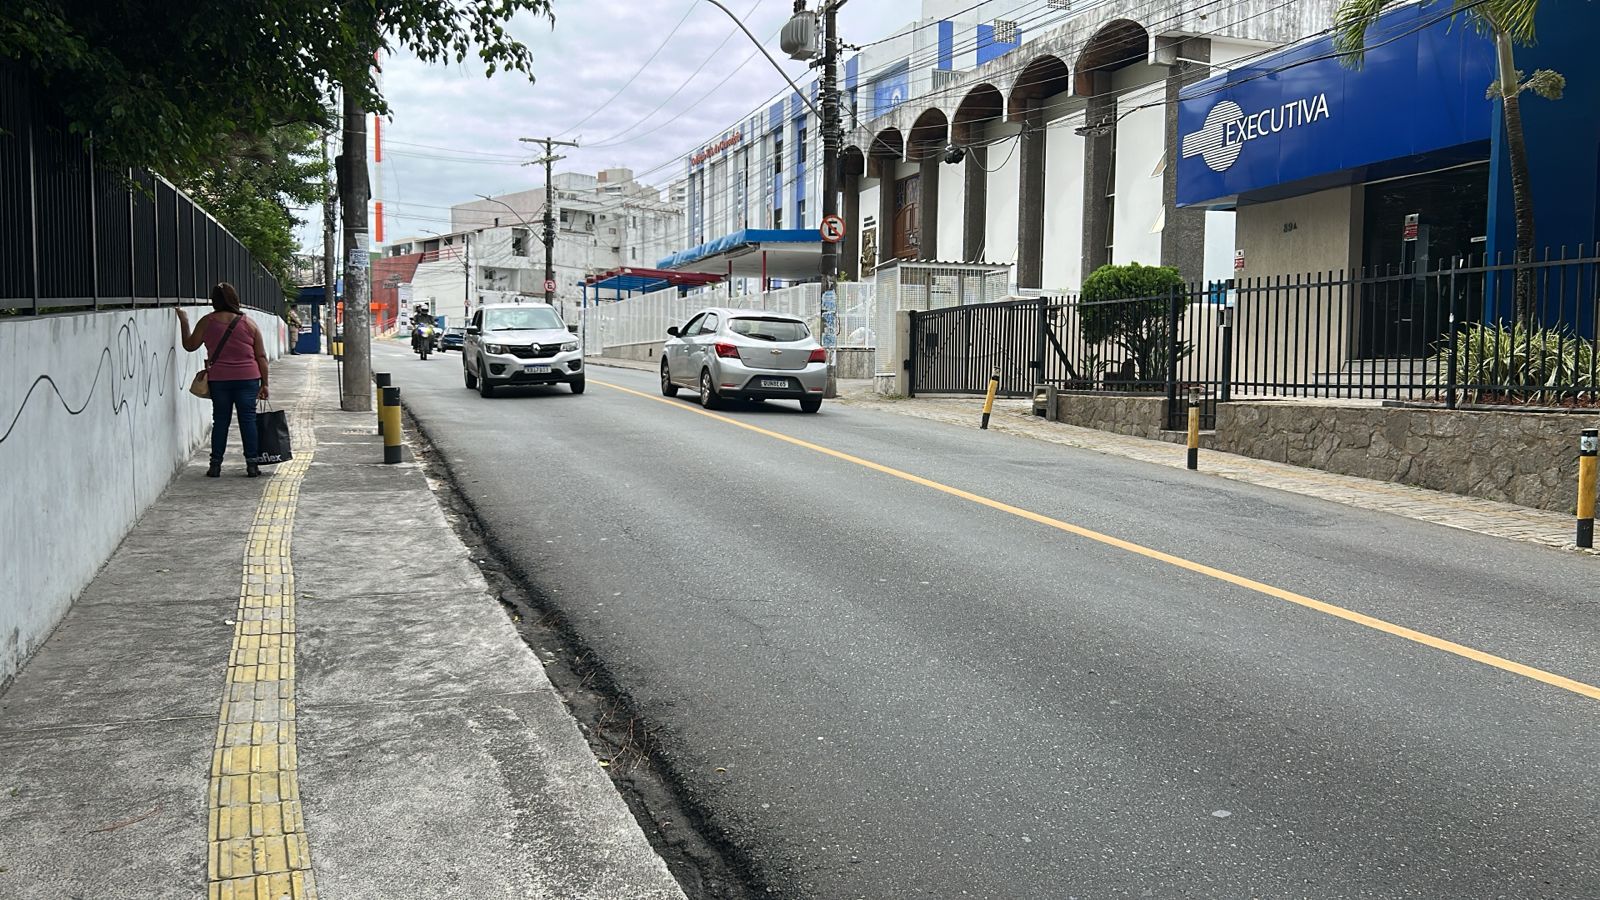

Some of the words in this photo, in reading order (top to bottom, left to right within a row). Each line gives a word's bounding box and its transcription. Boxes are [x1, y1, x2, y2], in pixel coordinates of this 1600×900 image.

[1226, 93, 1329, 145] EXECUTIVA
[828, 221, 838, 236] E
[257, 452, 282, 462] aflex
